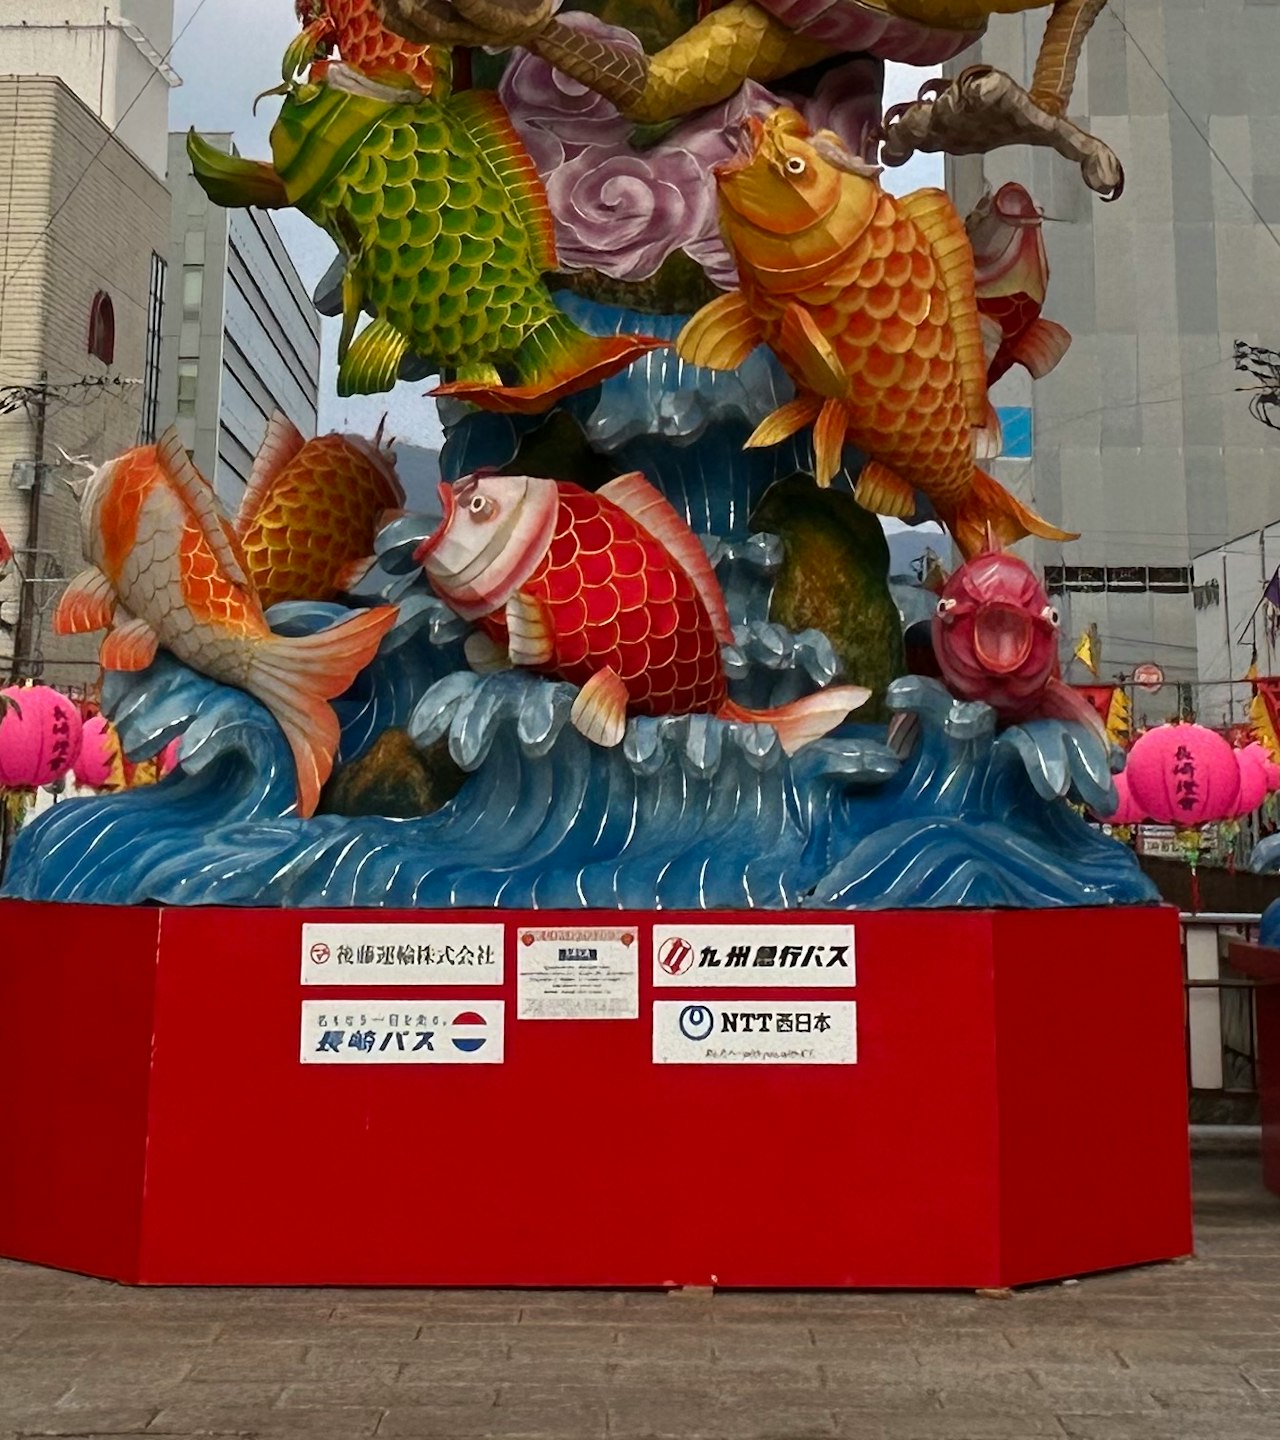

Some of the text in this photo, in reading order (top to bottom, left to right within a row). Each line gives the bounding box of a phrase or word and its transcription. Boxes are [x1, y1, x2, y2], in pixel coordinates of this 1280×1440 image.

[698, 945, 850, 968] 九州急行バス
[721, 1012, 832, 1034] NTT西日本
[315, 1029, 436, 1054] 長崎バス
